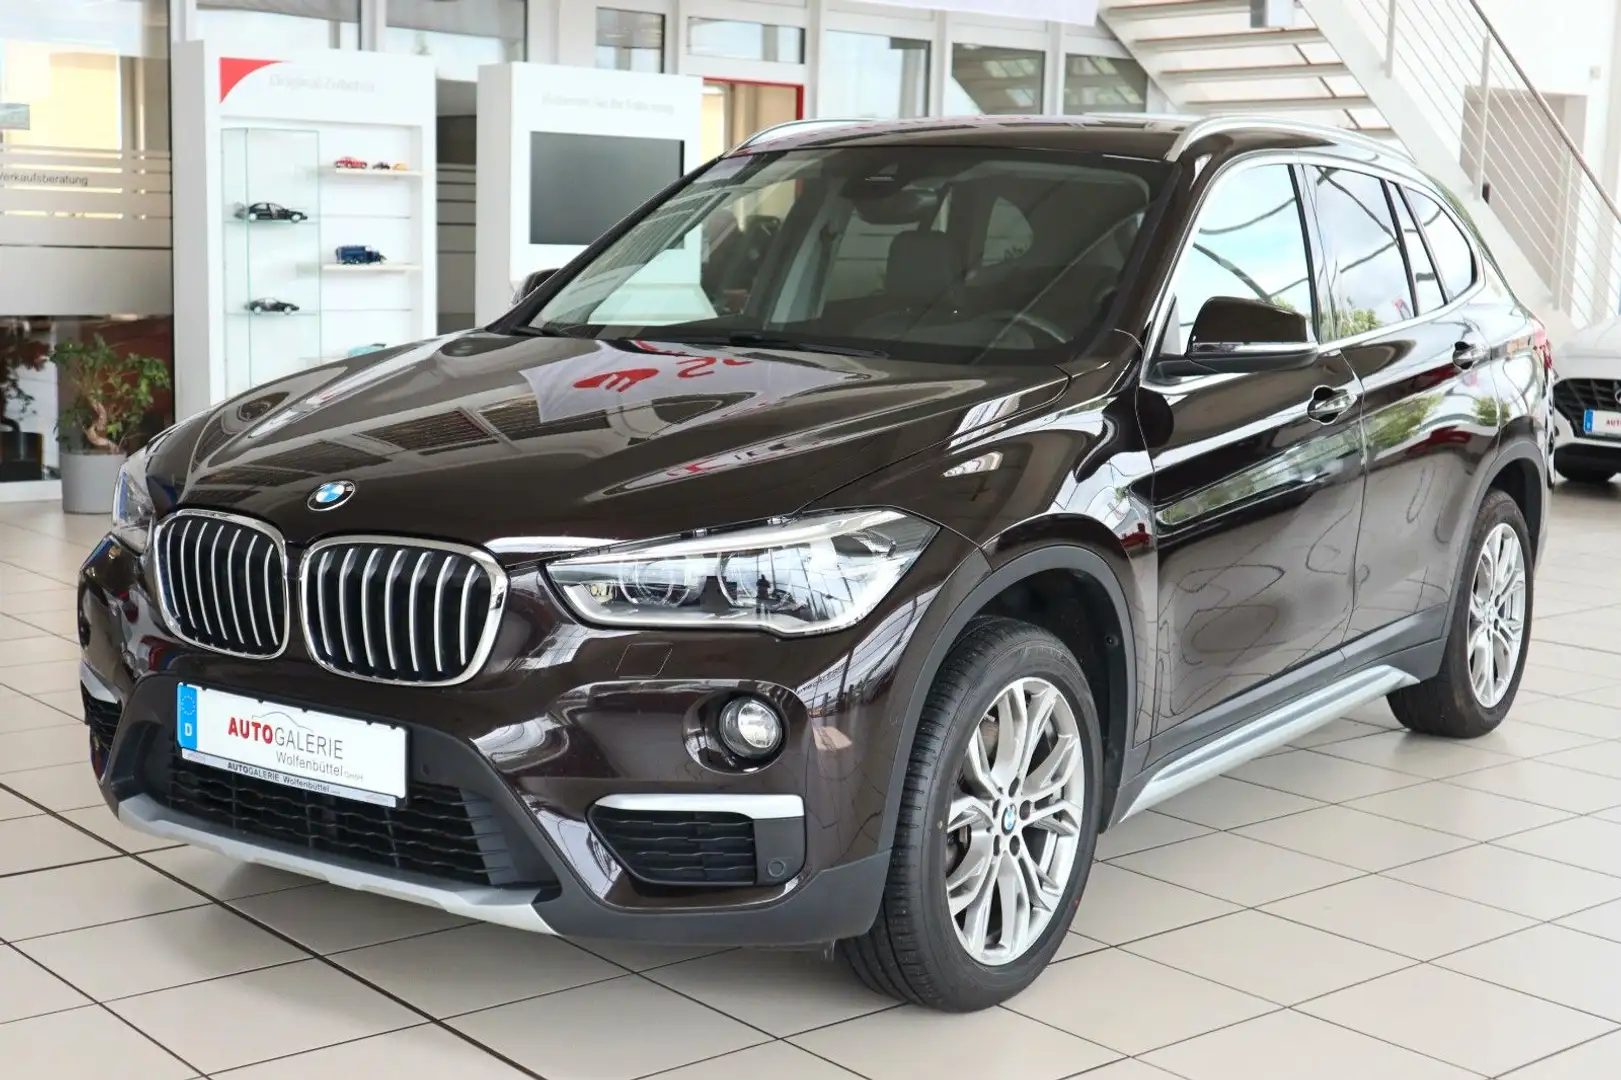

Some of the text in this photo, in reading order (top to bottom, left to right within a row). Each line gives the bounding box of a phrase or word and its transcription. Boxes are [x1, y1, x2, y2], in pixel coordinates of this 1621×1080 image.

[1606, 418, 1621, 427] AUT
[184, 722, 193, 737] D
[228, 716, 344, 760] AUTOGALERIE
[227, 761, 280, 783] AUTOGALERIE
[276, 750, 343, 777] Wolfenbüttel
